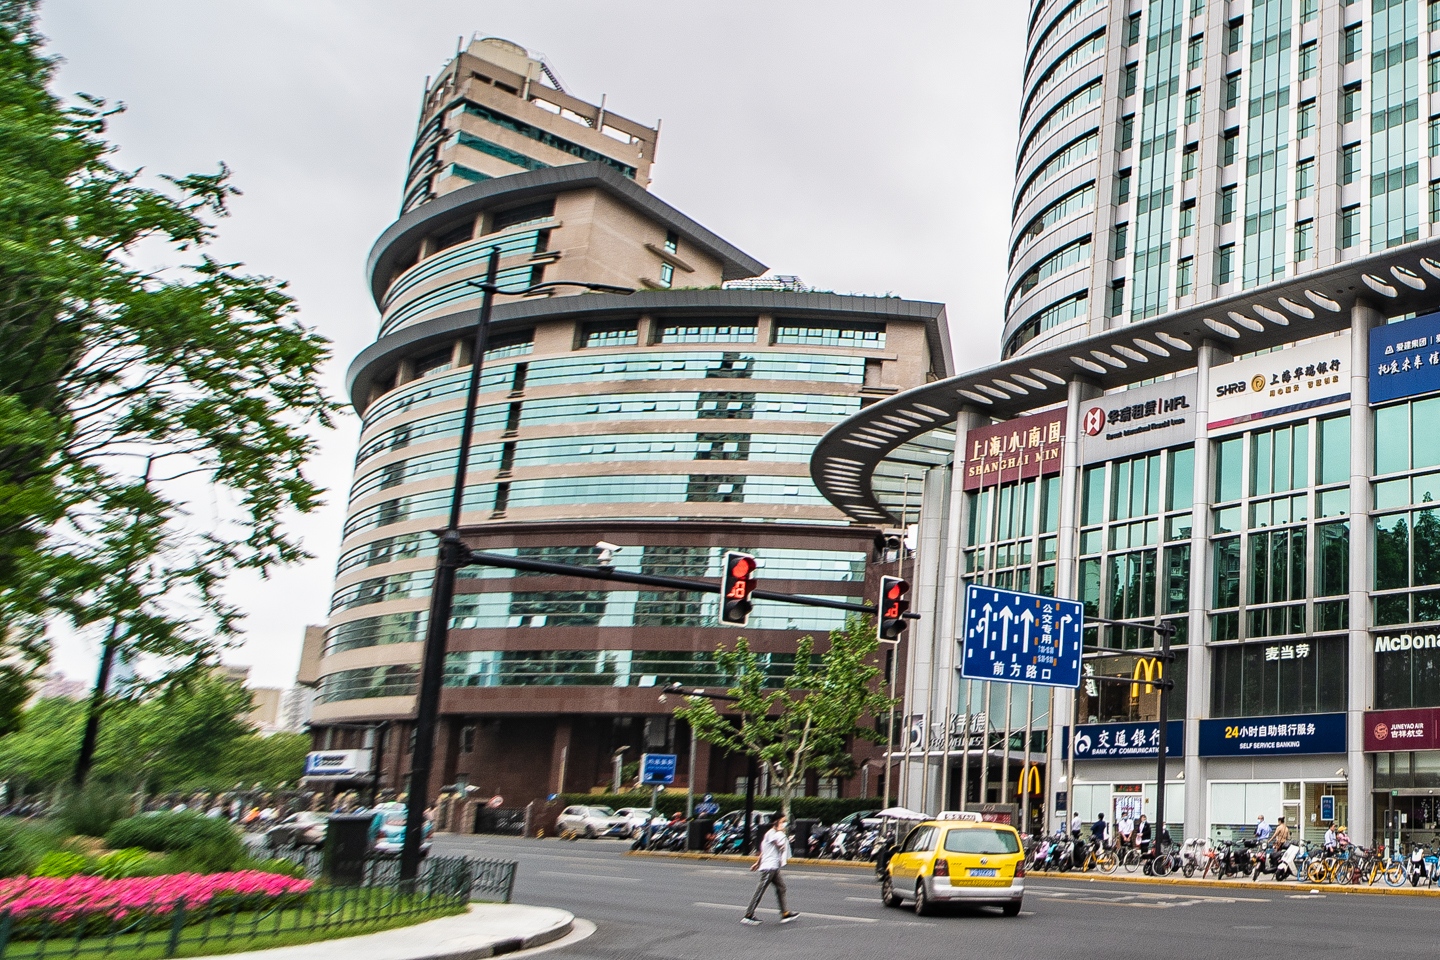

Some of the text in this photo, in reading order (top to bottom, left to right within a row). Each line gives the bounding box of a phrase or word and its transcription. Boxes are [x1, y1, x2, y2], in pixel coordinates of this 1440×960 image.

[1396, 337, 1427, 352] 爱建集团
[1269, 359, 1341, 386] 上海华瑞银行
[1216, 381, 1247, 397] SHRB
[1107, 400, 1158, 425] 华瑞租赁
[1163, 395, 1190, 413] HFL
[970, 421, 1062, 462] 上海小南国
[968, 448, 1060, 477] SHANGHAI MIN
[1041, 603, 1053, 645] 公交专用
[1265, 643, 1311, 662] 麦当劳
[993, 661, 1052, 680] 前方路口
[1225, 723, 1316, 739] 24小时自助银行服务
[1390, 722, 1424, 731] JUNEYAO AIR
[1390, 730, 1424, 738] 吉祥航空
[1097, 728, 1161, 748] 交通銀行
[1239, 740, 1300, 750] SELF SERVICE BANKING
[1091, 746, 1169, 756] BANK OF COMMUNICATIS
